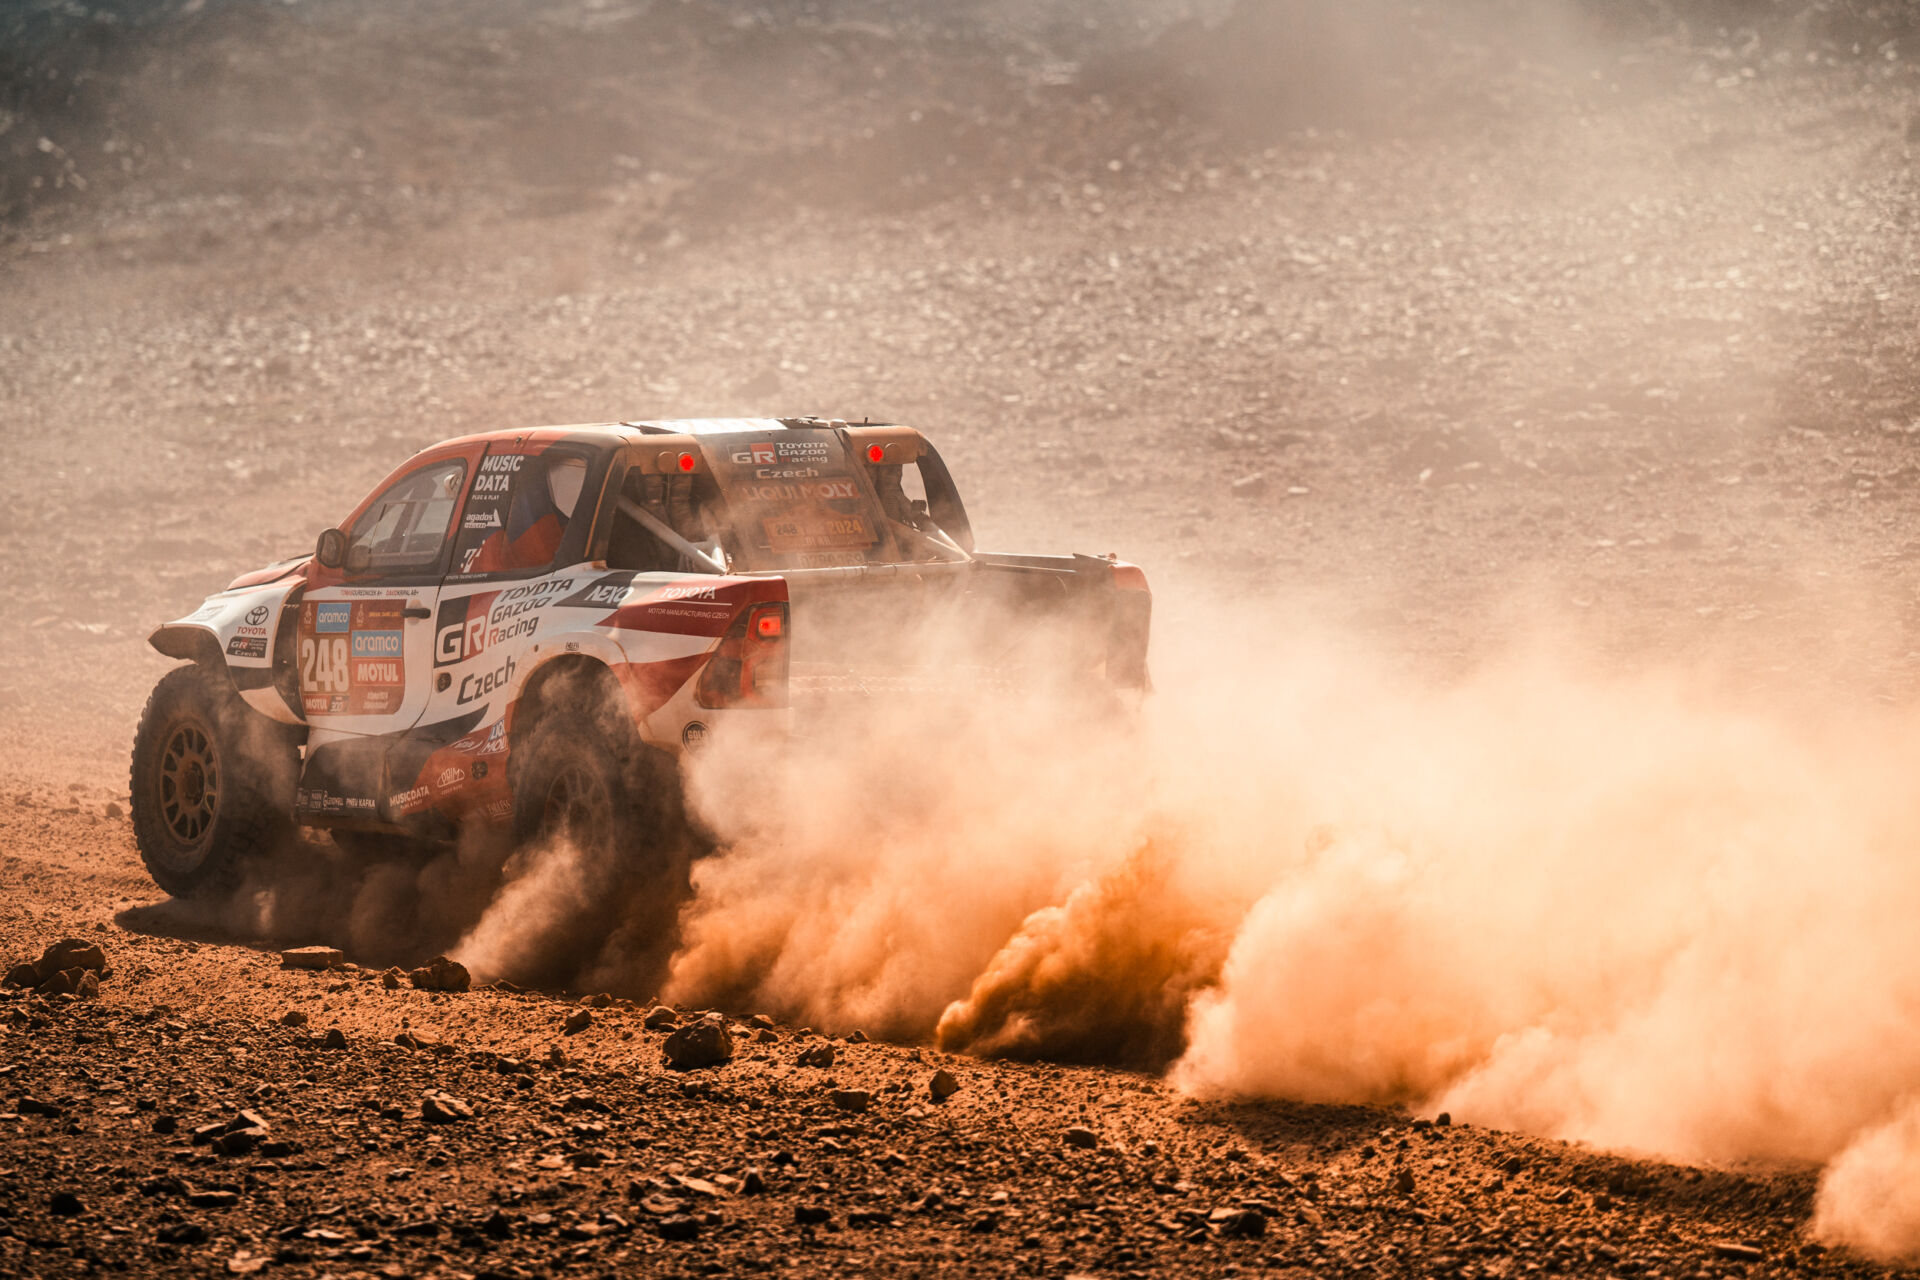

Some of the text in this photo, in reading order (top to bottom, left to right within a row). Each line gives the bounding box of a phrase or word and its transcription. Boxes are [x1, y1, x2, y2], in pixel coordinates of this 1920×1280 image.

[481, 456, 524, 472] MUSIC
[781, 455, 828, 464] Racing
[756, 467, 819, 479] Czech
[474, 475, 509, 491] DATA
[466, 512, 493, 522] agados
[828, 519, 862, 534] 2024
[501, 579, 575, 602] TOYOTA
[660, 586, 716, 599] TOYOTA
[318, 610, 349, 624] aramco
[491, 597, 552, 625] GAZOO
[647, 607, 730, 619] MOTOR MANUFACTURING CZECH
[237, 626, 267, 635] TOYOTA
[488, 616, 539, 648] Racing
[356, 636, 399, 651] aramco
[436, 615, 486, 663] GR
[302, 638, 349, 692] 248
[357, 663, 399, 682] MOTUL
[457, 655, 516, 705] Czech
[305, 698, 328, 710] MOTUL
[390, 786, 430, 807] MUSICDATA
